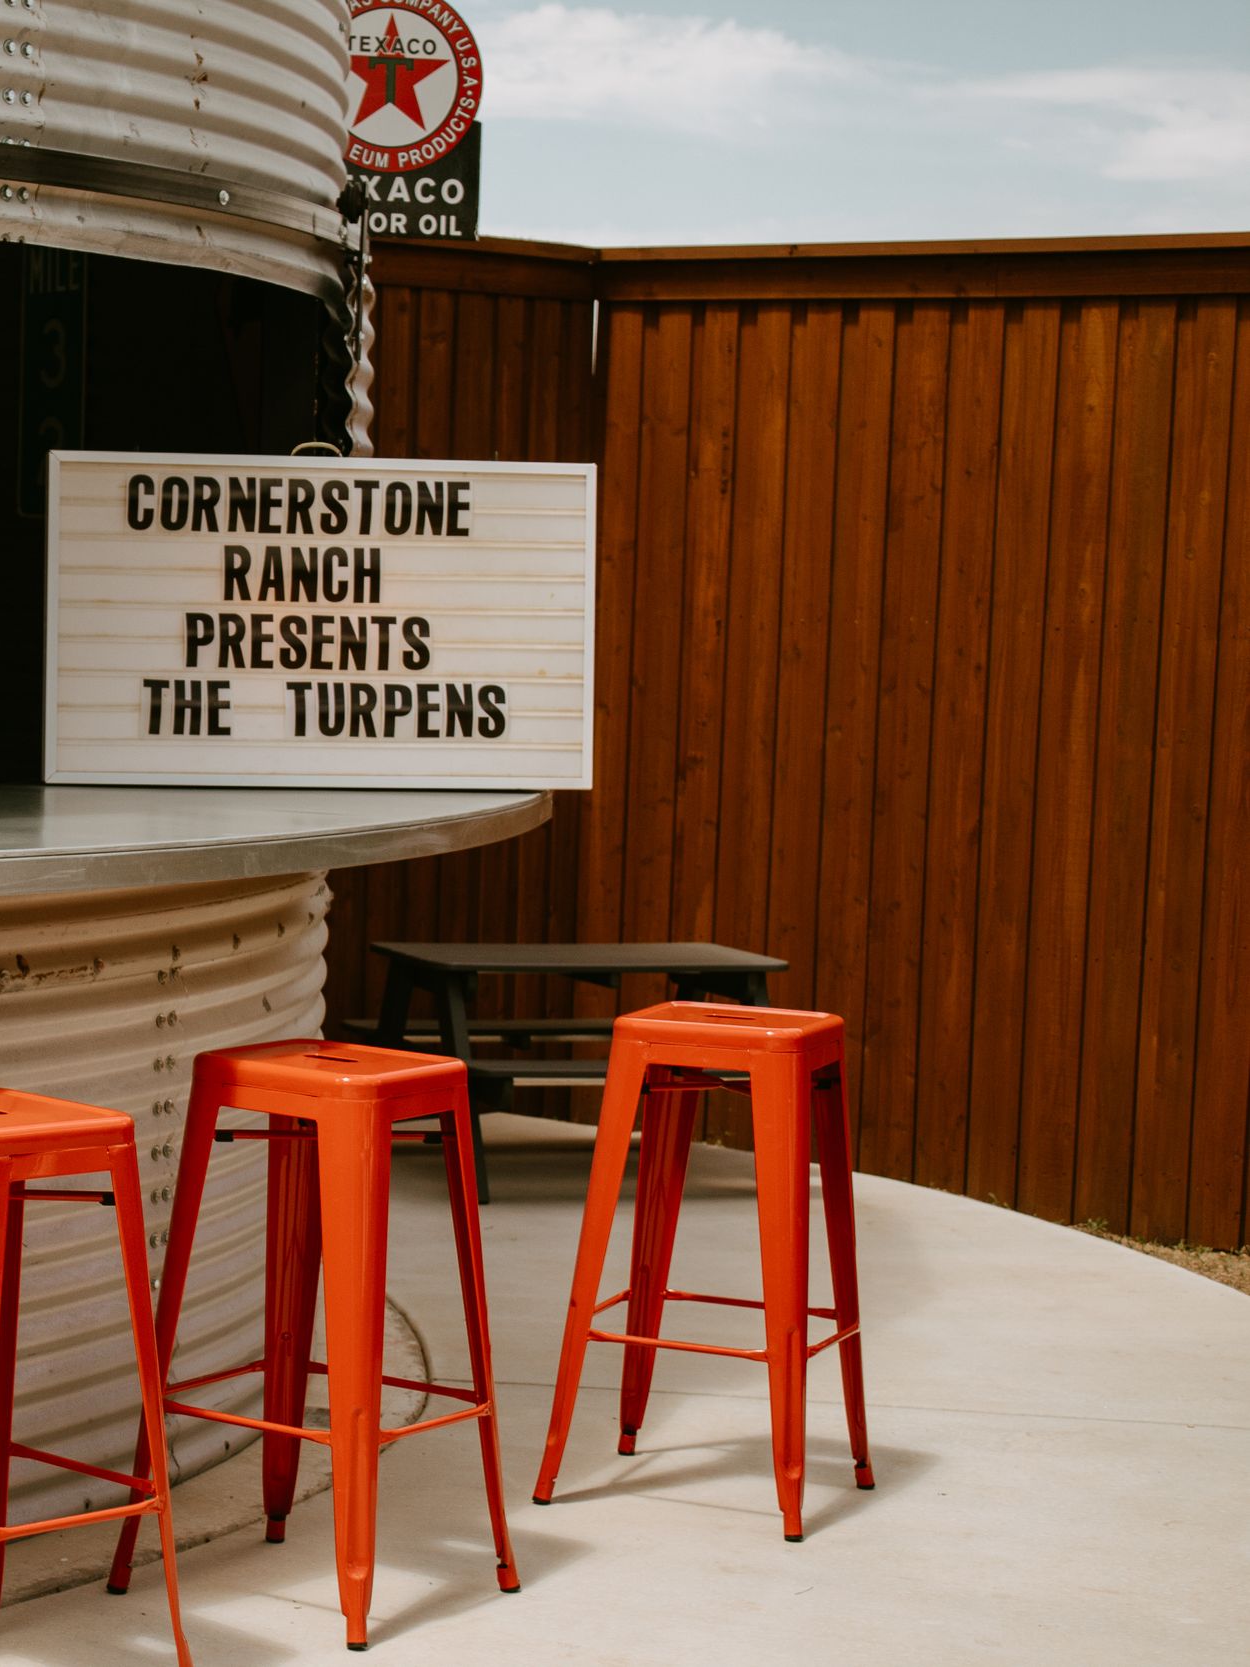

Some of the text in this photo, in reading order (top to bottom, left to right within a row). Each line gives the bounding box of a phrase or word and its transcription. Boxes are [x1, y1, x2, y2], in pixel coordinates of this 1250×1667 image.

[379, 0, 463, 34] PANY
[348, 35, 436, 55] TEXACO
[368, 57, 414, 104] T
[397, 97, 476, 168] PRODUCTS
[347, 174, 465, 204] XACO
[418, 214, 463, 236] OIL
[29, 249, 80, 294] MILE
[127, 474, 471, 537] CORNERSTONE
[223, 545, 381, 603] RANCH
[185, 612, 431, 671] PRESENTS
[143, 678, 506, 738] THE TURPENS
